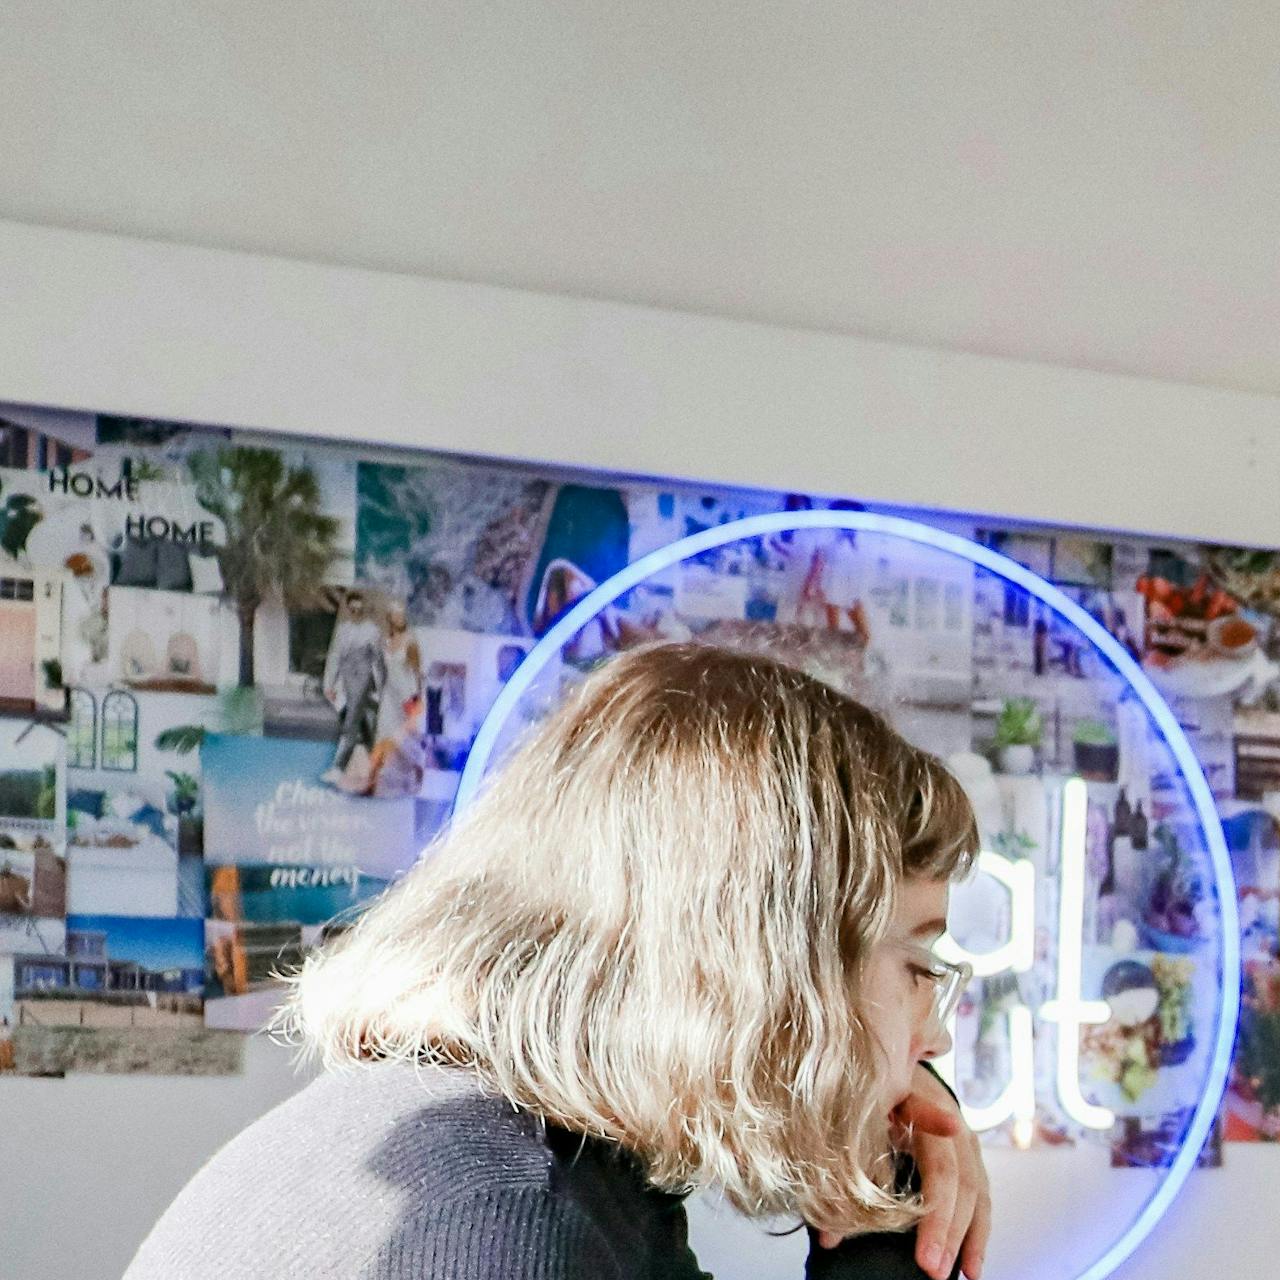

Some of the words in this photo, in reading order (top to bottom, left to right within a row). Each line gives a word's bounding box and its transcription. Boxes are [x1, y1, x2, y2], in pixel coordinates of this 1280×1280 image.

[50, 467, 139, 502] HOME
[126, 513, 214, 545] HOME
[270, 865, 359, 899] money
